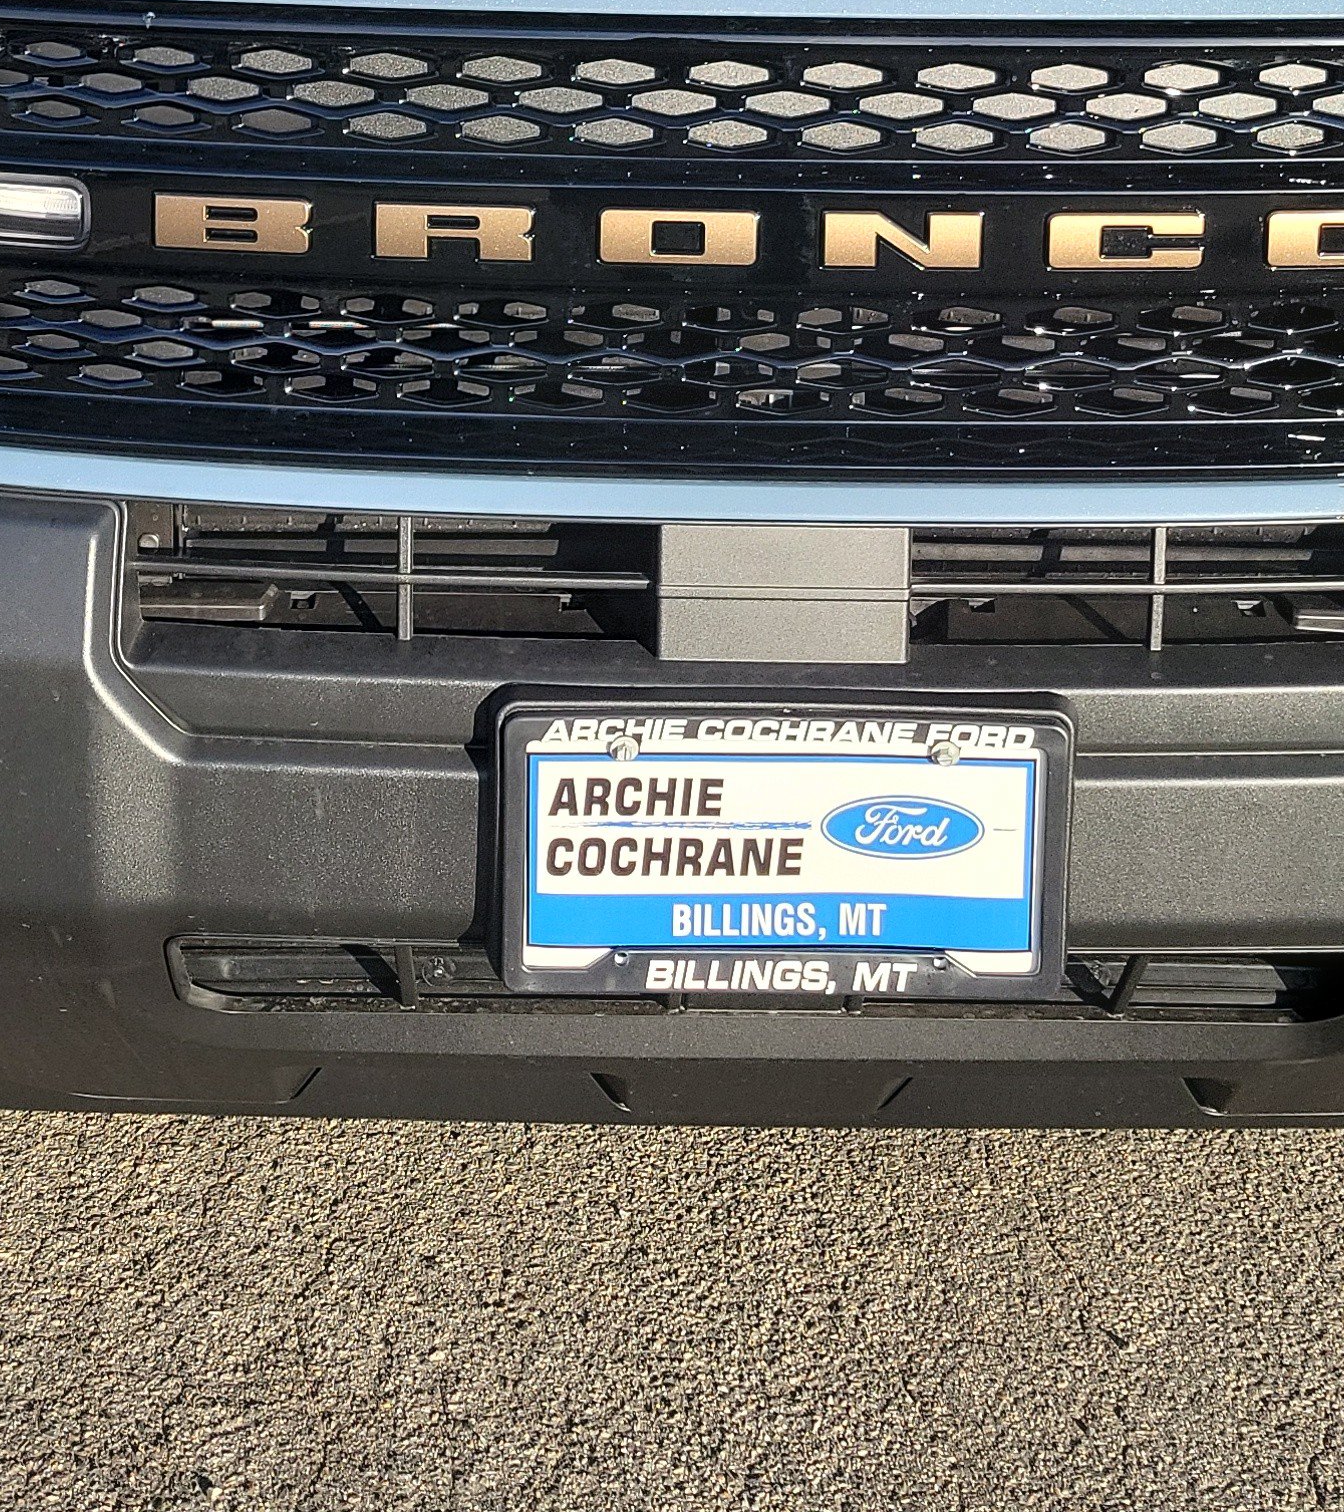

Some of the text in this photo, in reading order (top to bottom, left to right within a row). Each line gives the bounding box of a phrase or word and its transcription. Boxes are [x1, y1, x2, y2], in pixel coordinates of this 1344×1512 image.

[540, 717, 1036, 751] ARCHIE COCHRANE FORD
[548, 776, 725, 818] ARCHIE
[854, 800, 950, 848] Ford
[545, 836, 805, 878] COCHRANE
[672, 902, 888, 941] BILLINGS, MT
[644, 959, 919, 996] BILLINGS, MT
